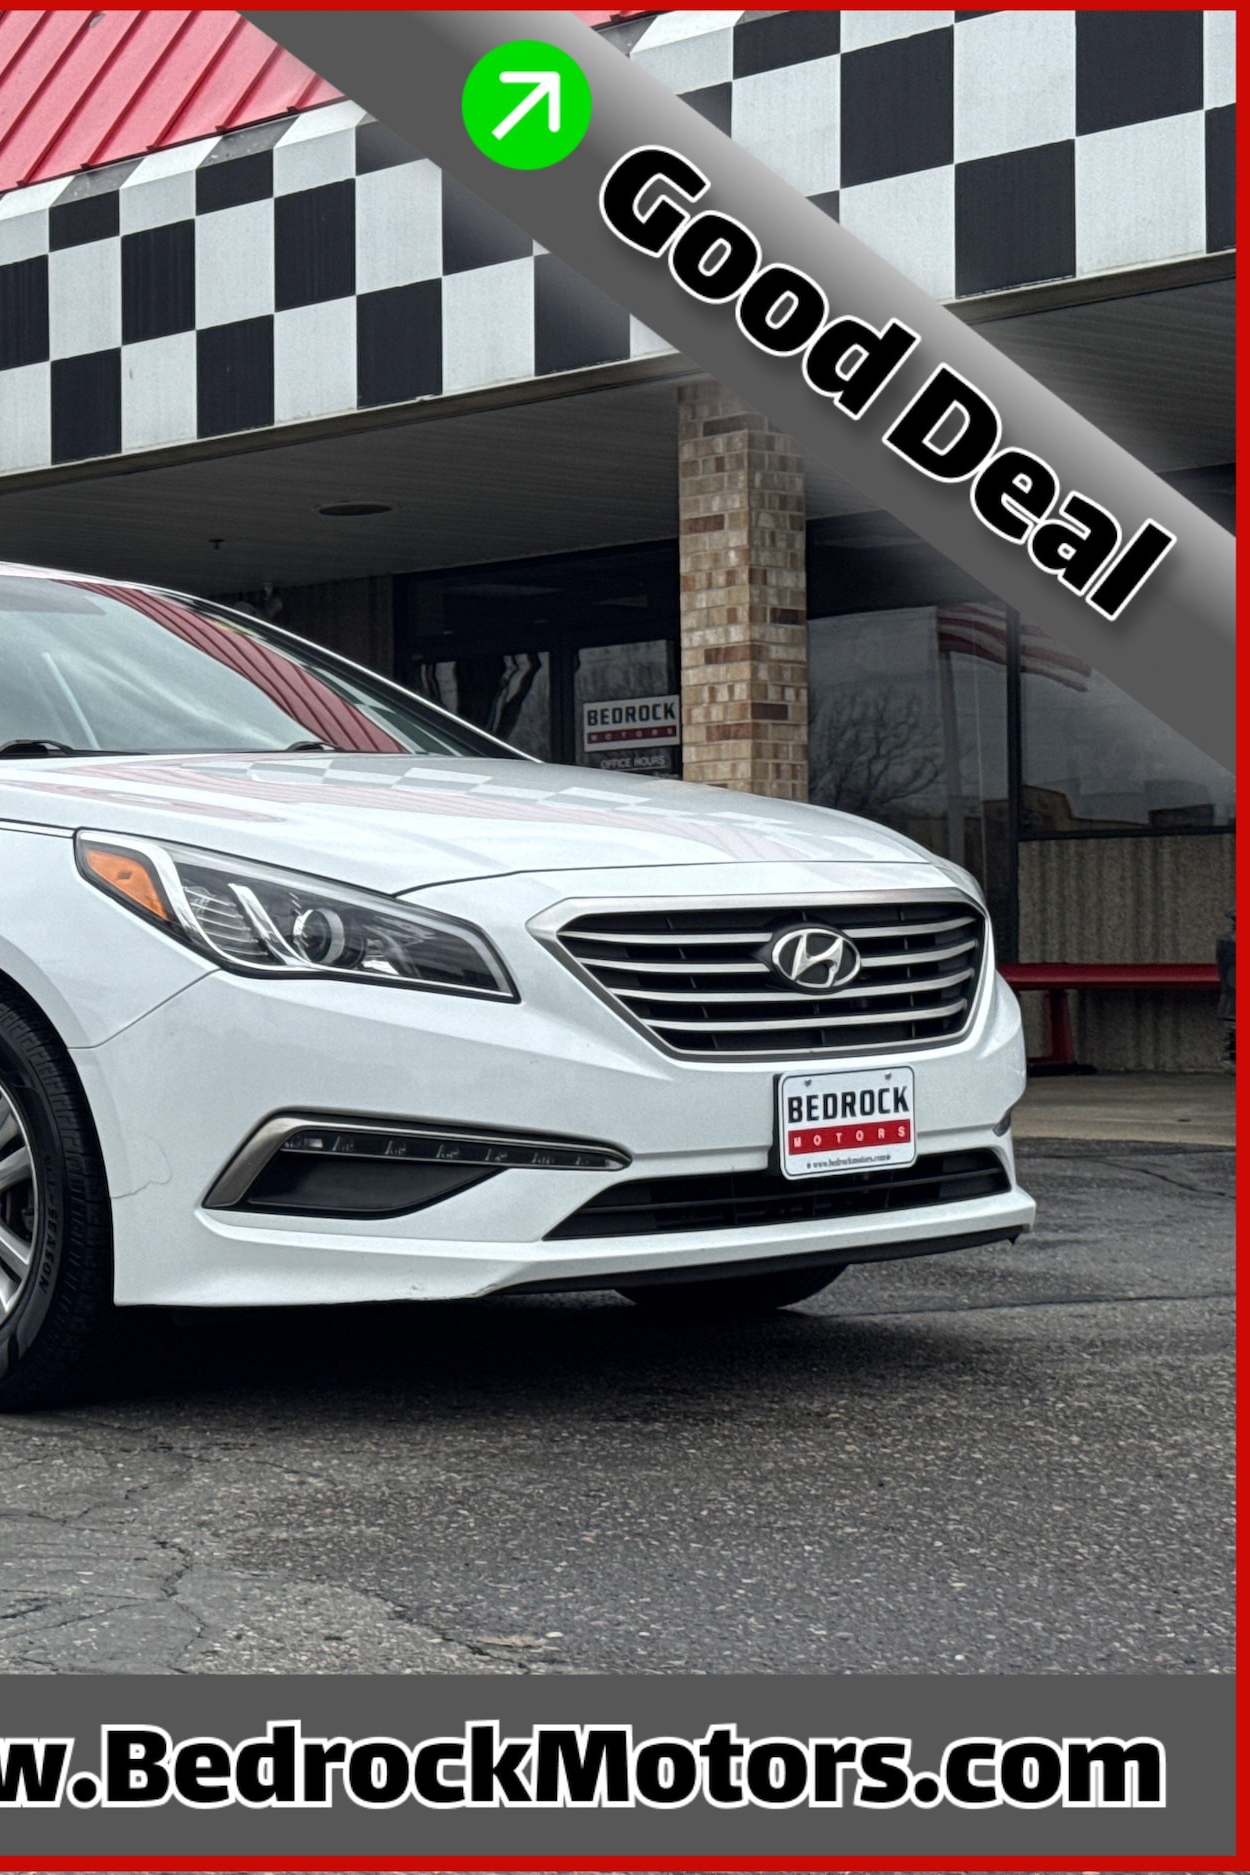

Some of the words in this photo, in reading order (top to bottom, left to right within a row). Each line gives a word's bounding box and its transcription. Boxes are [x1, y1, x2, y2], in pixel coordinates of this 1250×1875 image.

[587, 702, 676, 726] BEDROCK
[788, 1086, 909, 1123] BEDROCK
[794, 1126, 905, 1147] MOTORS
